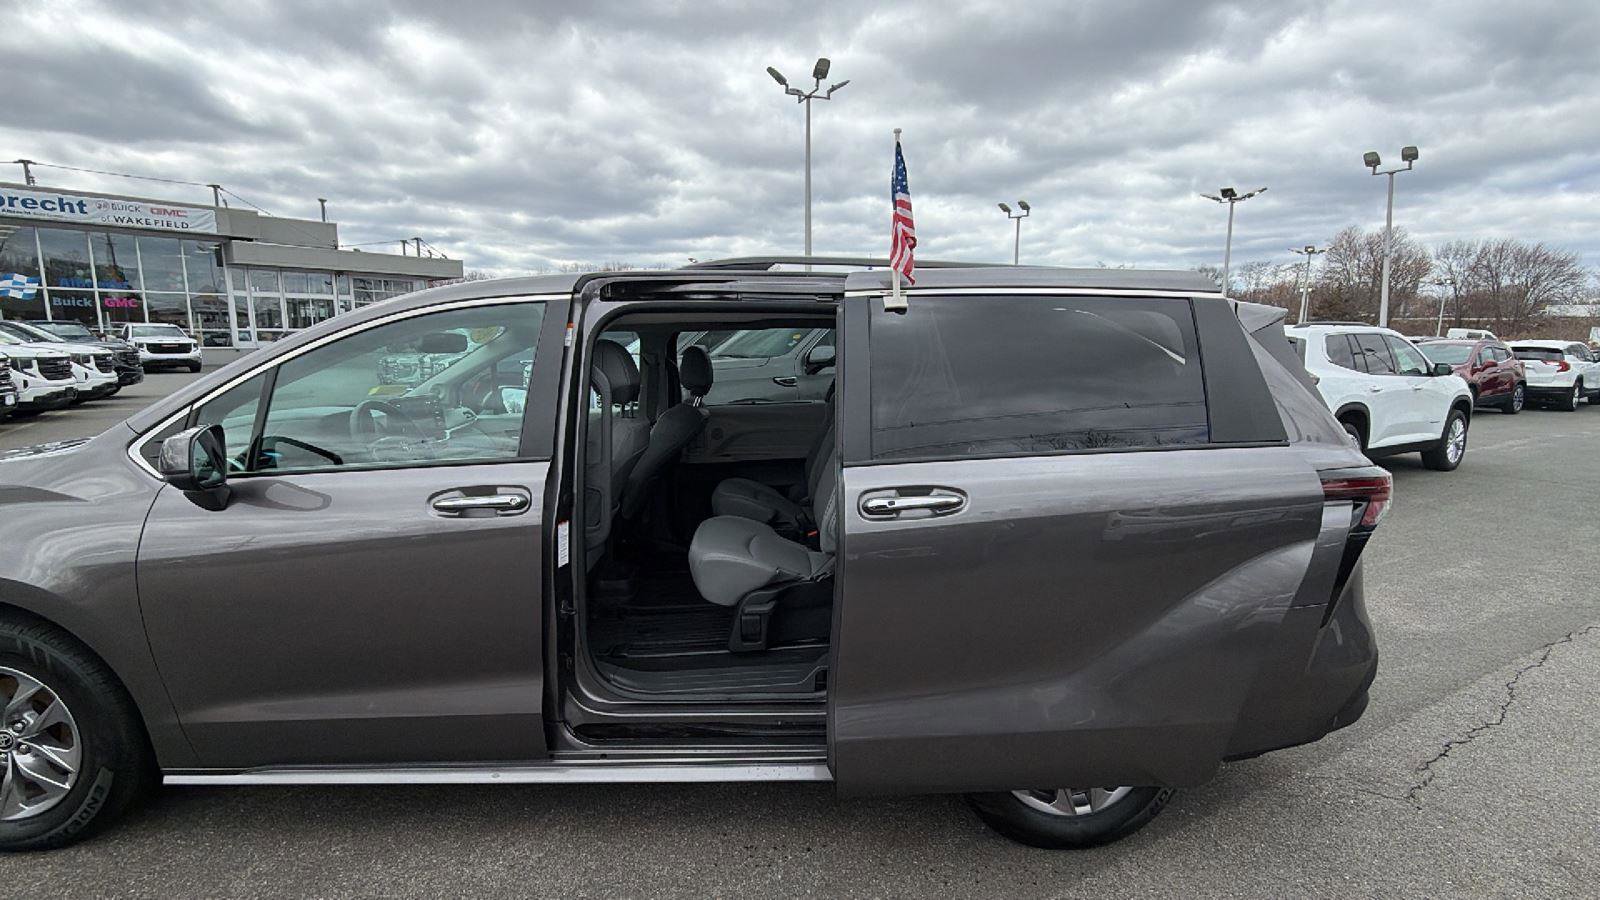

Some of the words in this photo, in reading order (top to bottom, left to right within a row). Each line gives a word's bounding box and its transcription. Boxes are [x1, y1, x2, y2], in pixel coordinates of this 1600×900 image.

[111, 203, 141, 212] BUICK
[150, 207, 188, 217] GMC
[113, 215, 189, 229] WAKEFIELD
[52, 296, 93, 307] Buick
[104, 297, 138, 308] GMC
